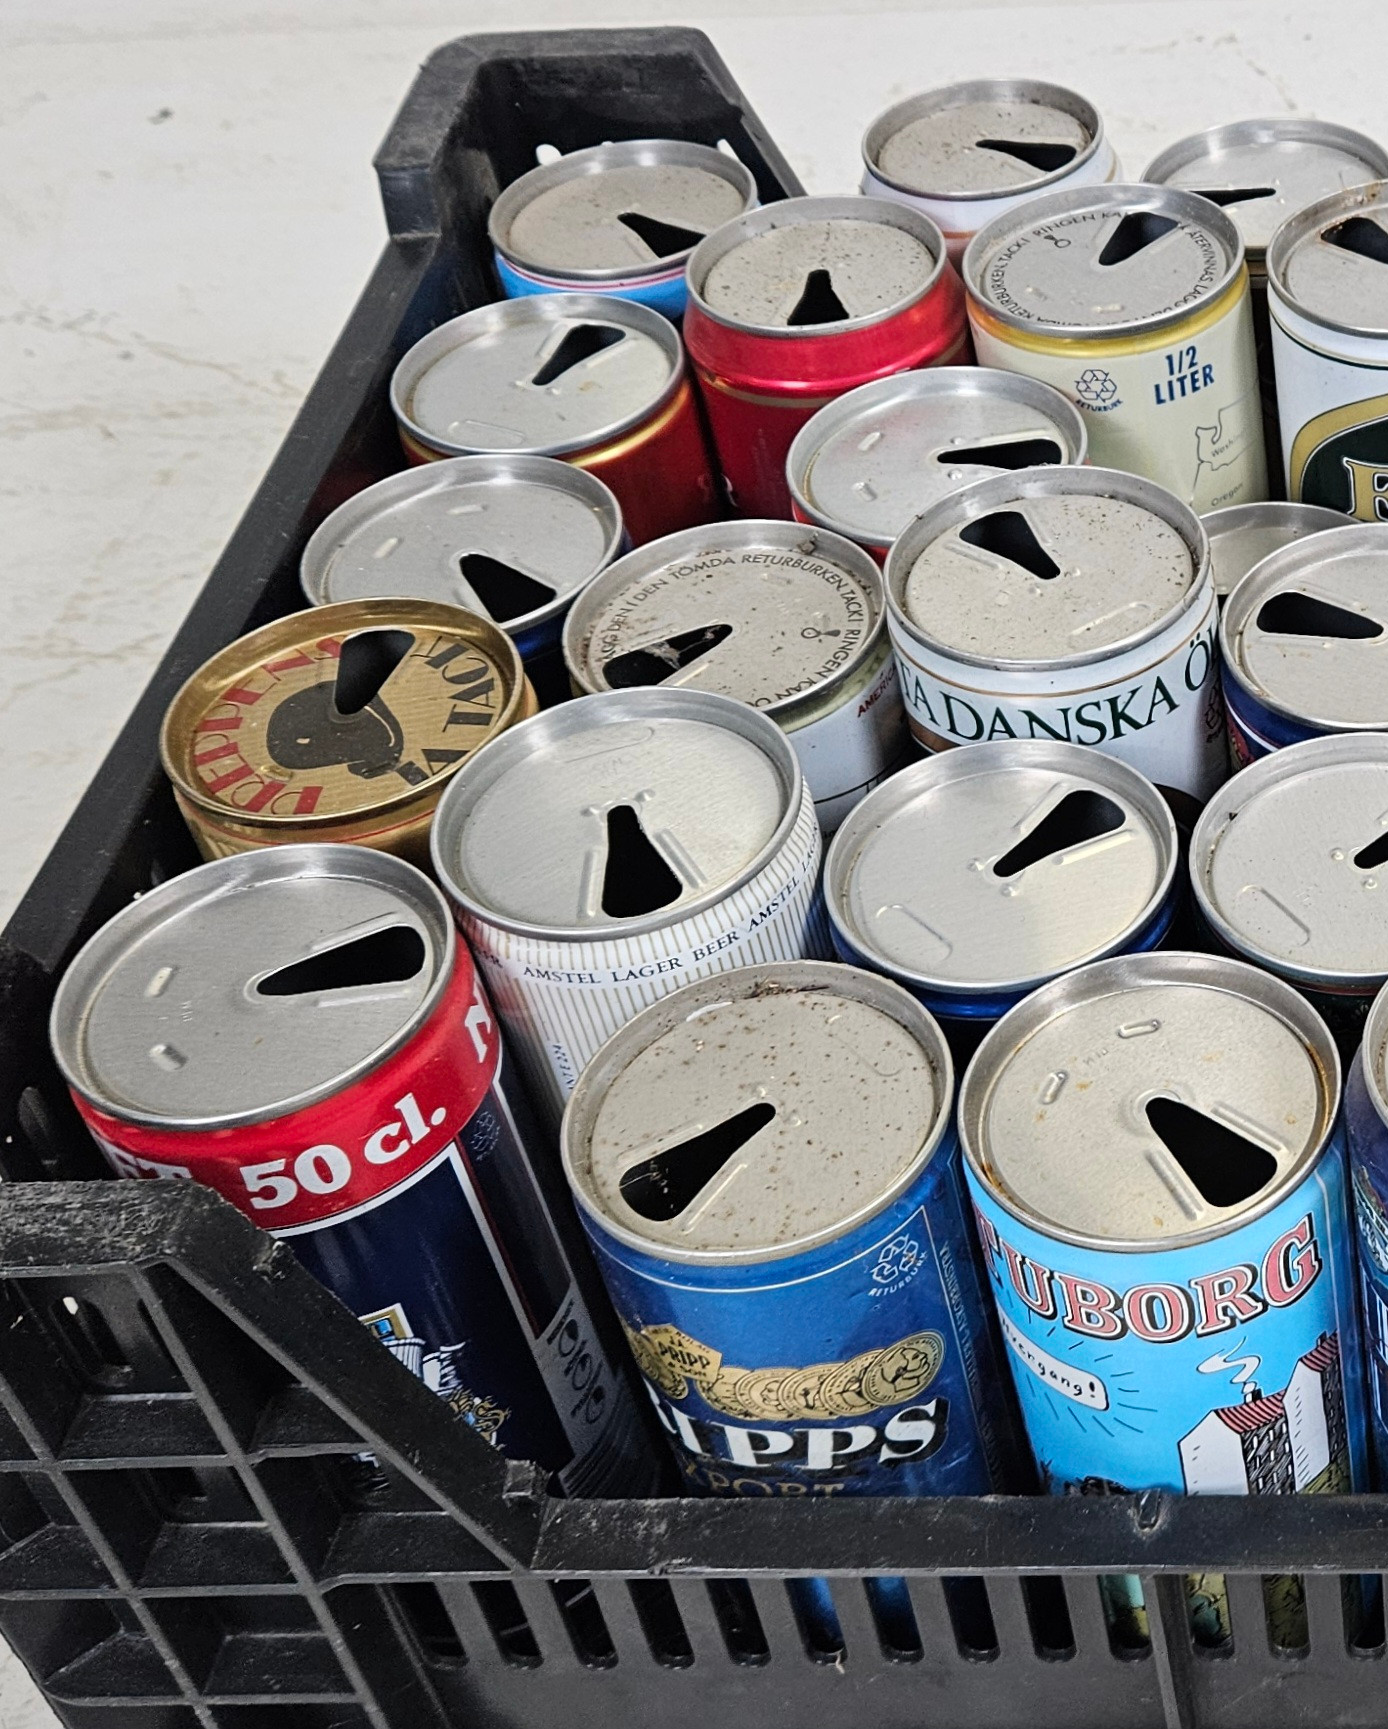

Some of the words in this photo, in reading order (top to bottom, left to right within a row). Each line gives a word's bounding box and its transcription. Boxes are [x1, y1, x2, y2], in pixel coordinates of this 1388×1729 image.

[1154, 363, 1215, 405] LITER
[1166, 345, 1198, 376] 1/2
[634, 577, 668, 604] DEN
[670, 555, 736, 580] TÖMDA
[814, 628, 863, 683] RINGEN
[940, 675, 1181, 747] DANSKA
[522, 964, 603, 985] AMSTEL
[610, 956, 685, 984] LAGER
[692, 930, 742, 963] BEER
[747, 876, 801, 933] AMSTEL
[239, 1143, 353, 1210] 50
[362, 1092, 447, 1167] cl.
[971, 1198, 1324, 1345] TUBORG
